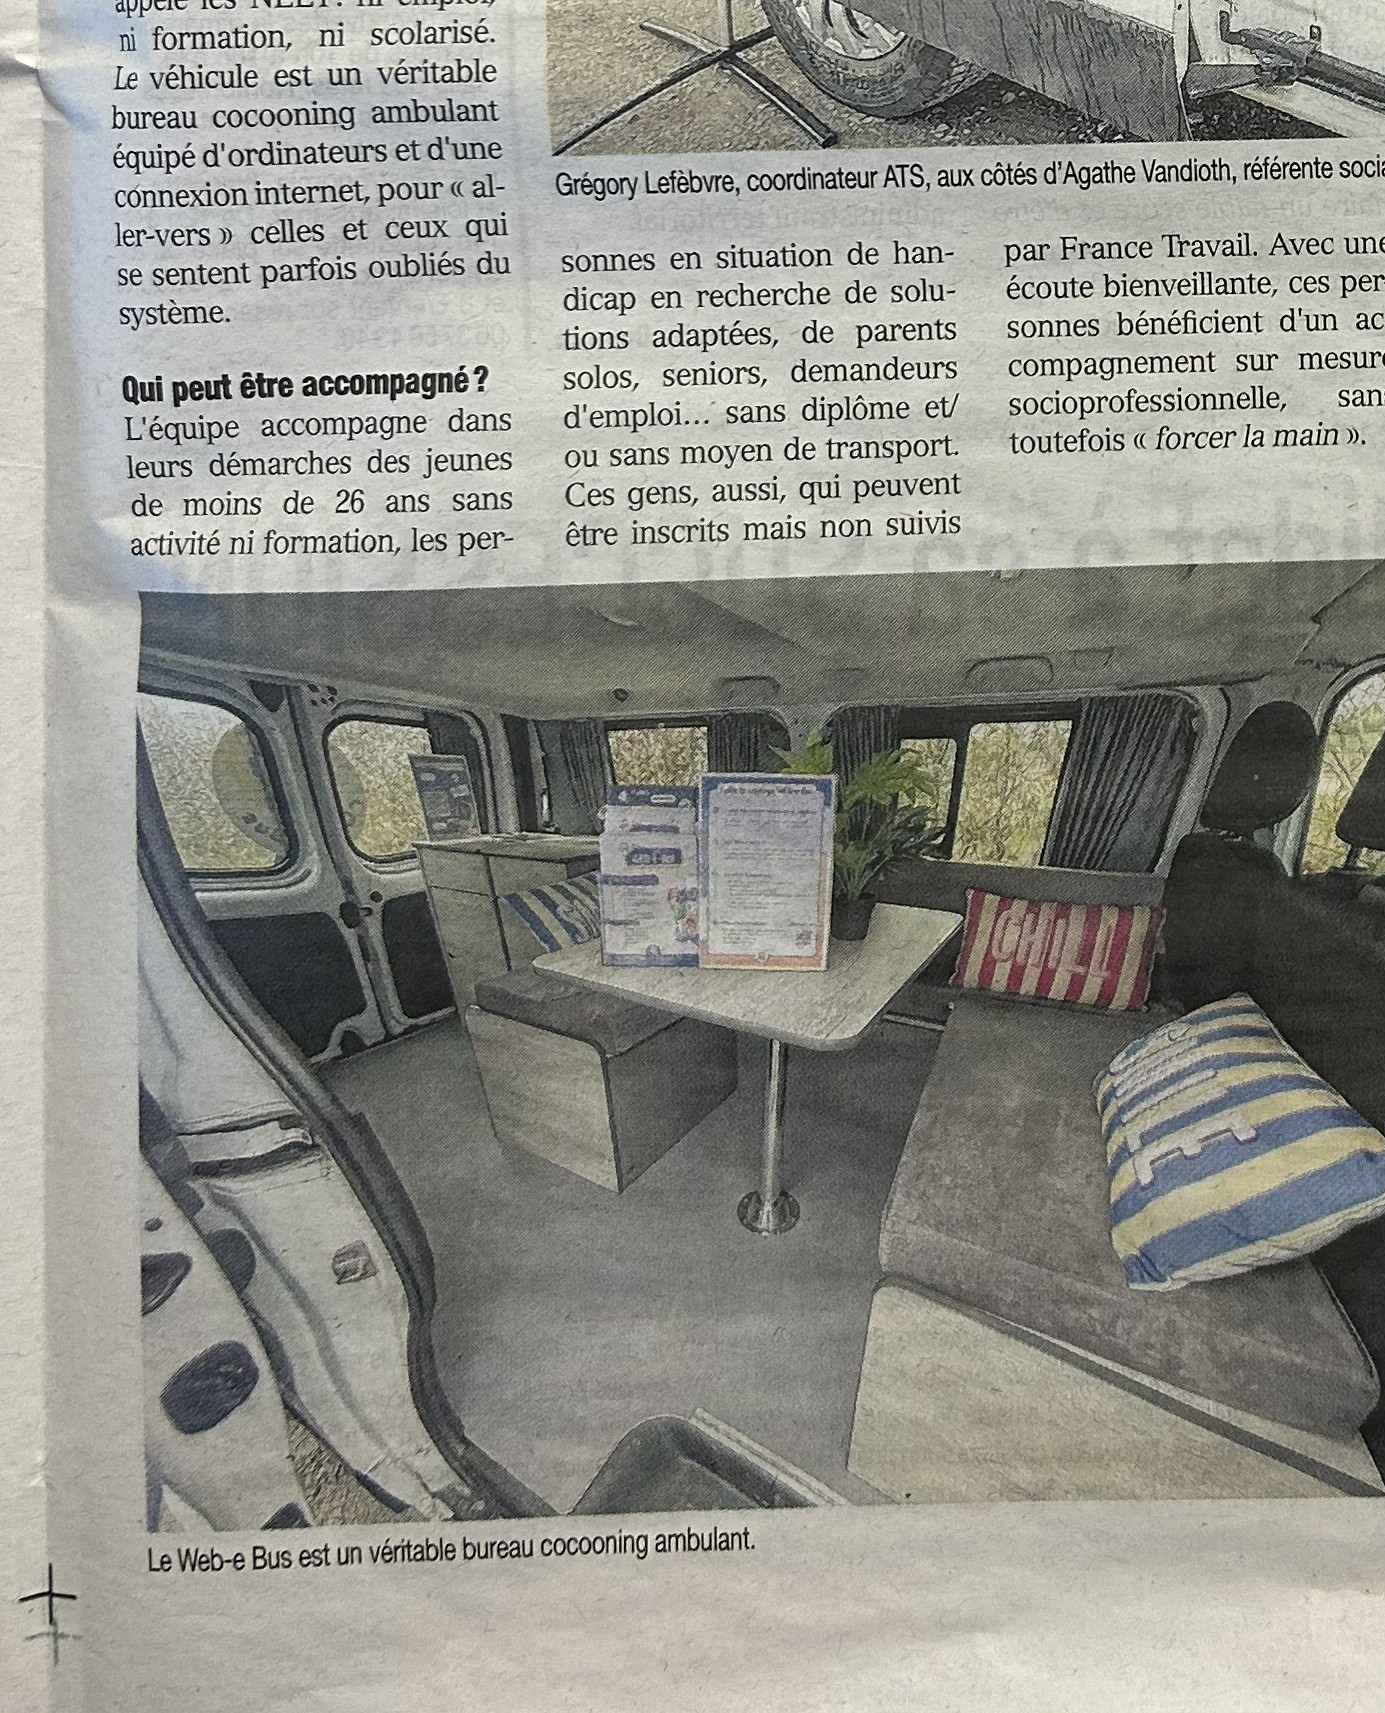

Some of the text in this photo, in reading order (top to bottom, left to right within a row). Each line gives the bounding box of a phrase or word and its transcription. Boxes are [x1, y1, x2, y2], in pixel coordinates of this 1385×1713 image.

[555, 171, 639, 202] Grégory
[644, 169, 741, 197] Lefèbvre,
[746, 166, 879, 192] coordinateur
[882, 163, 931, 193] ATS,
[937, 168, 975, 188] aux
[980, 161, 1038, 187] côtés
[1043, 159, 1136, 191] d'Agathe
[1140, 157, 1237, 186] Vandioth,
[1243, 155, 1334, 181] référente
[1003, 243, 1051, 268] par
[1059, 236, 1154, 261] France
[1161, 232, 1258, 258] Travail.
[1268, 232, 1335, 256] Avec
[561, 318, 957, 353] tions adaptées, de parents
[122, 375, 164, 406] Qui
[171, 373, 233, 408] peut
[239, 371, 294, 400] être
[147, 1525, 756, 1573] Le Web-e Bus est un véritable bureau cocooning ambulant.
